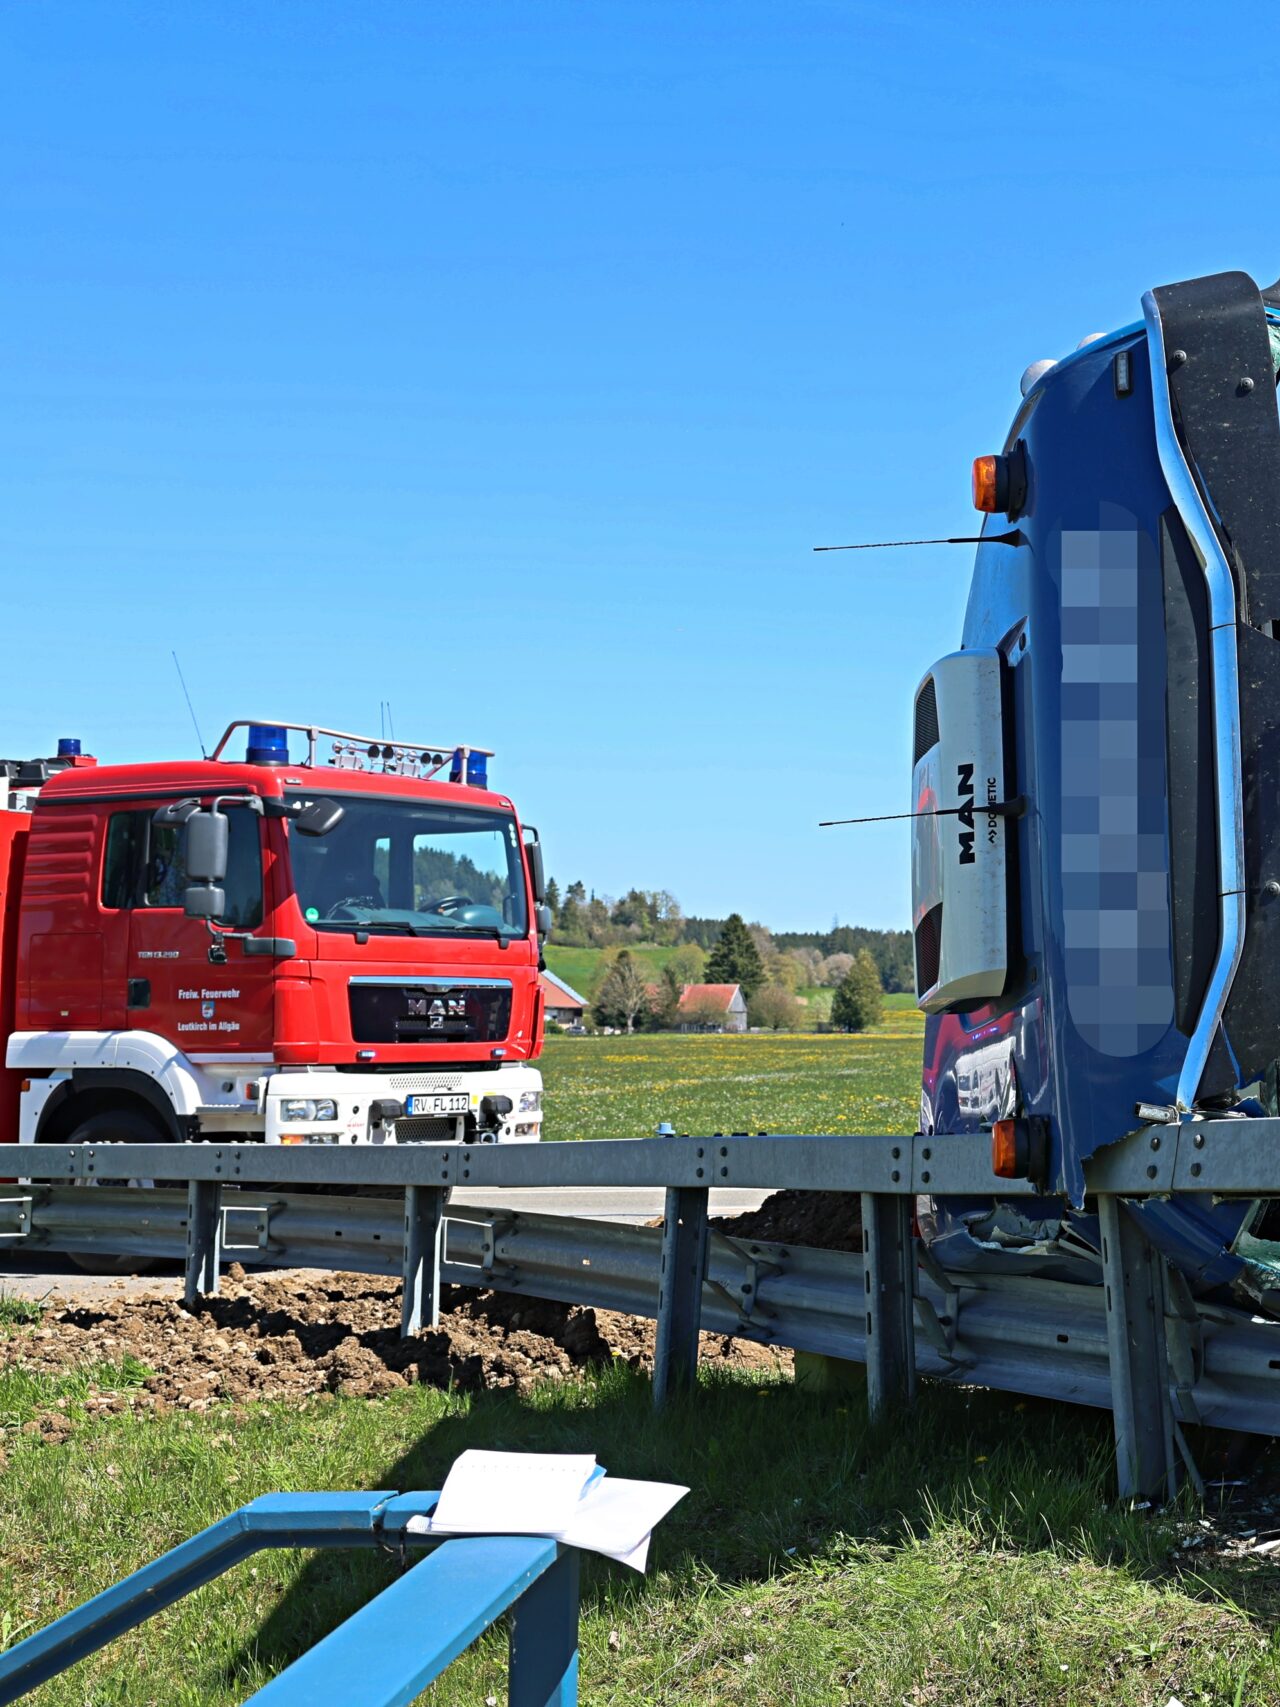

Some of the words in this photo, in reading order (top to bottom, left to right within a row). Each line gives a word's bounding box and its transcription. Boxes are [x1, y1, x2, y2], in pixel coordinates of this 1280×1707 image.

[957, 763, 975, 865] MAN
[178, 989, 200, 1000] Freiw.
[201, 988, 240, 999] Feuerwehr
[408, 999, 466, 1015] MAN
[177, 1022, 208, 1032] Leutkirch
[209, 1022, 217, 1031] im
[218, 1021, 240, 1033] Allgäu
[413, 1098, 427, 1112] RV
[433, 1097, 447, 1111] FL
[449, 1096, 467, 1111] 112
